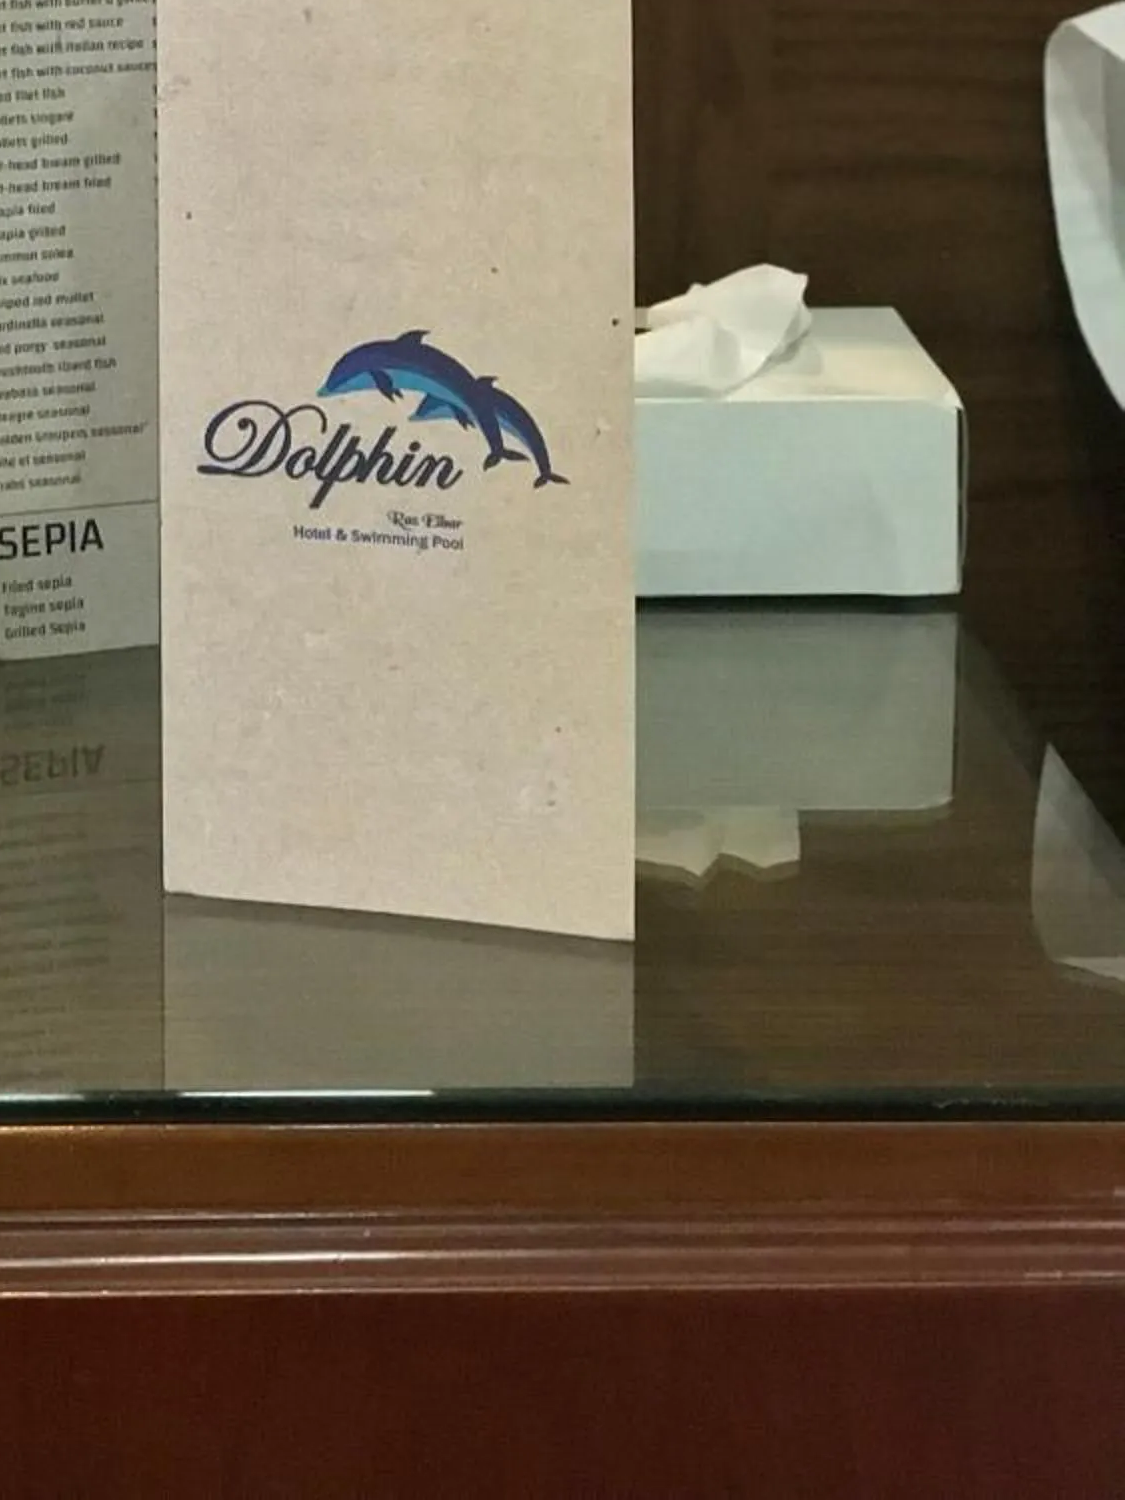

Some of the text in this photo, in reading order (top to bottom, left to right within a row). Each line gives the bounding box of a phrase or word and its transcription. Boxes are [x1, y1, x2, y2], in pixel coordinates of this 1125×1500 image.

[10, 21, 32, 32] fish
[35, 20, 62, 31] with
[65, 18, 86, 30] red
[89, 17, 124, 28] sauce
[10, 44, 33, 56] fish
[36, 41, 63, 54] with
[10, 67, 34, 79] fish
[36, 65, 63, 77] with
[42, 88, 65, 100] fish
[11, 272, 59, 285] seafood
[50, 314, 105, 327] seasonal
[53, 335, 106, 350] seasonal
[94, 357, 117, 369] fish
[196, 399, 463, 509] Dolphin
[293, 525, 465, 550] Hotel & Swimming Pool
[37, 574, 72, 591] sepia
[49, 597, 84, 613] sepia
